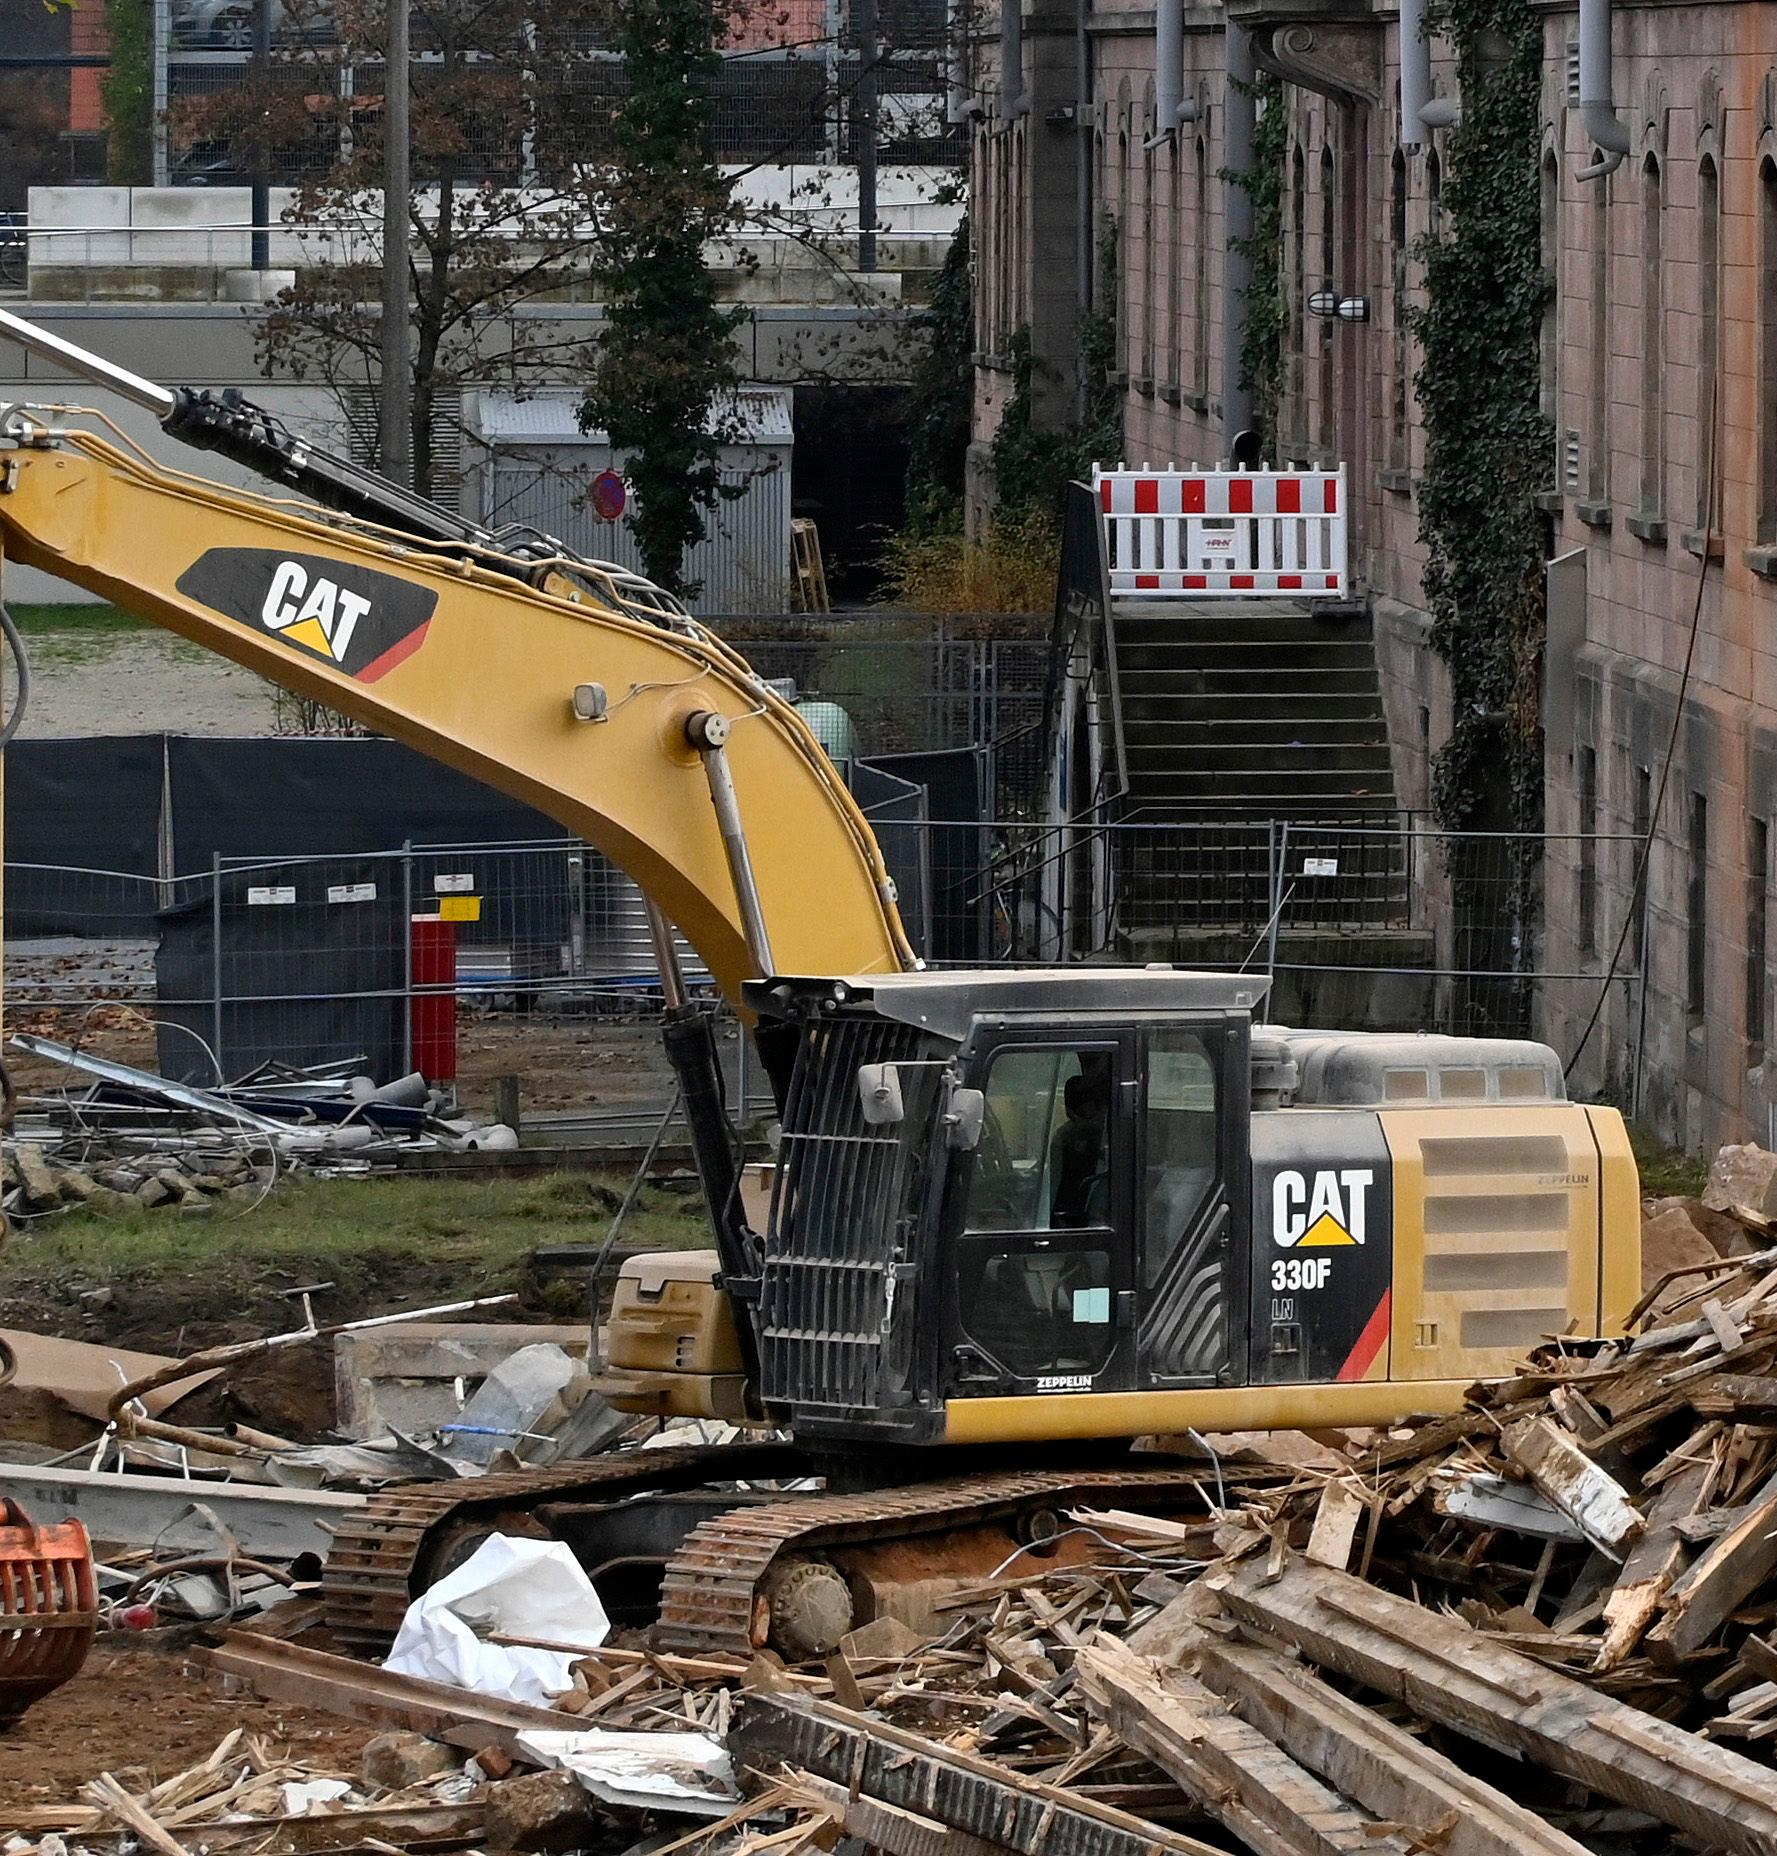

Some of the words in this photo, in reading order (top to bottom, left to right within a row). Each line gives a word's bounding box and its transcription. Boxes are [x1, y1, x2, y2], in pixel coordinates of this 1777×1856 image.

[262, 561, 372, 662] CAT
[1273, 1169, 1374, 1248] CAT
[1271, 1258, 1332, 1291] 330F
[1271, 1298, 1294, 1321] LN
[1037, 1376, 1092, 1388] ZEPPELIN
